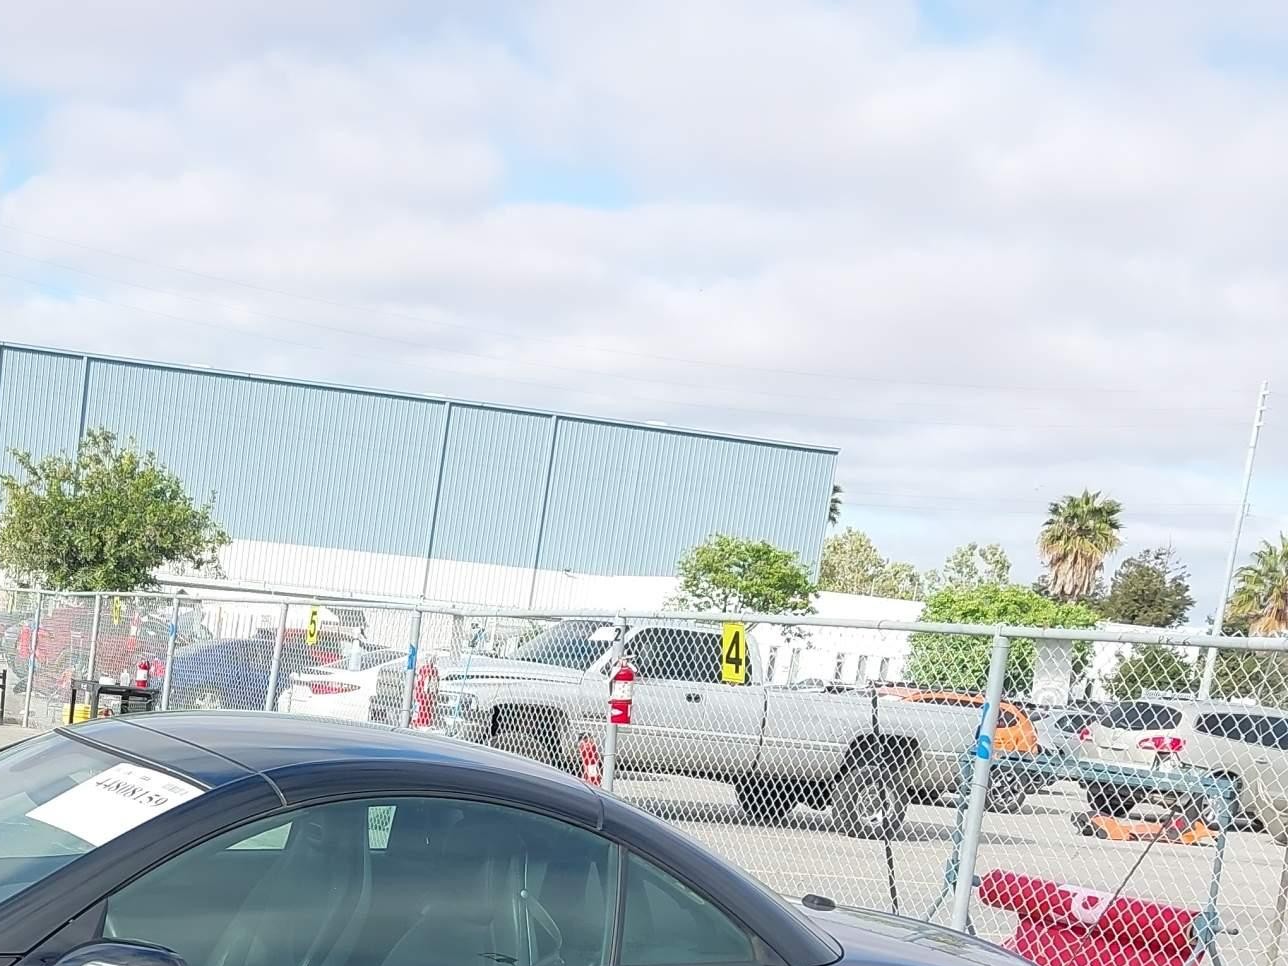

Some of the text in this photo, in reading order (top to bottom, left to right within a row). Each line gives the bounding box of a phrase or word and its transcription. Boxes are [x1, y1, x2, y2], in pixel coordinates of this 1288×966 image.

[309, 610, 317, 638] 5
[613, 627, 622, 642] 2
[725, 630, 743, 674] 4
[95, 777, 169, 807] 44808159
